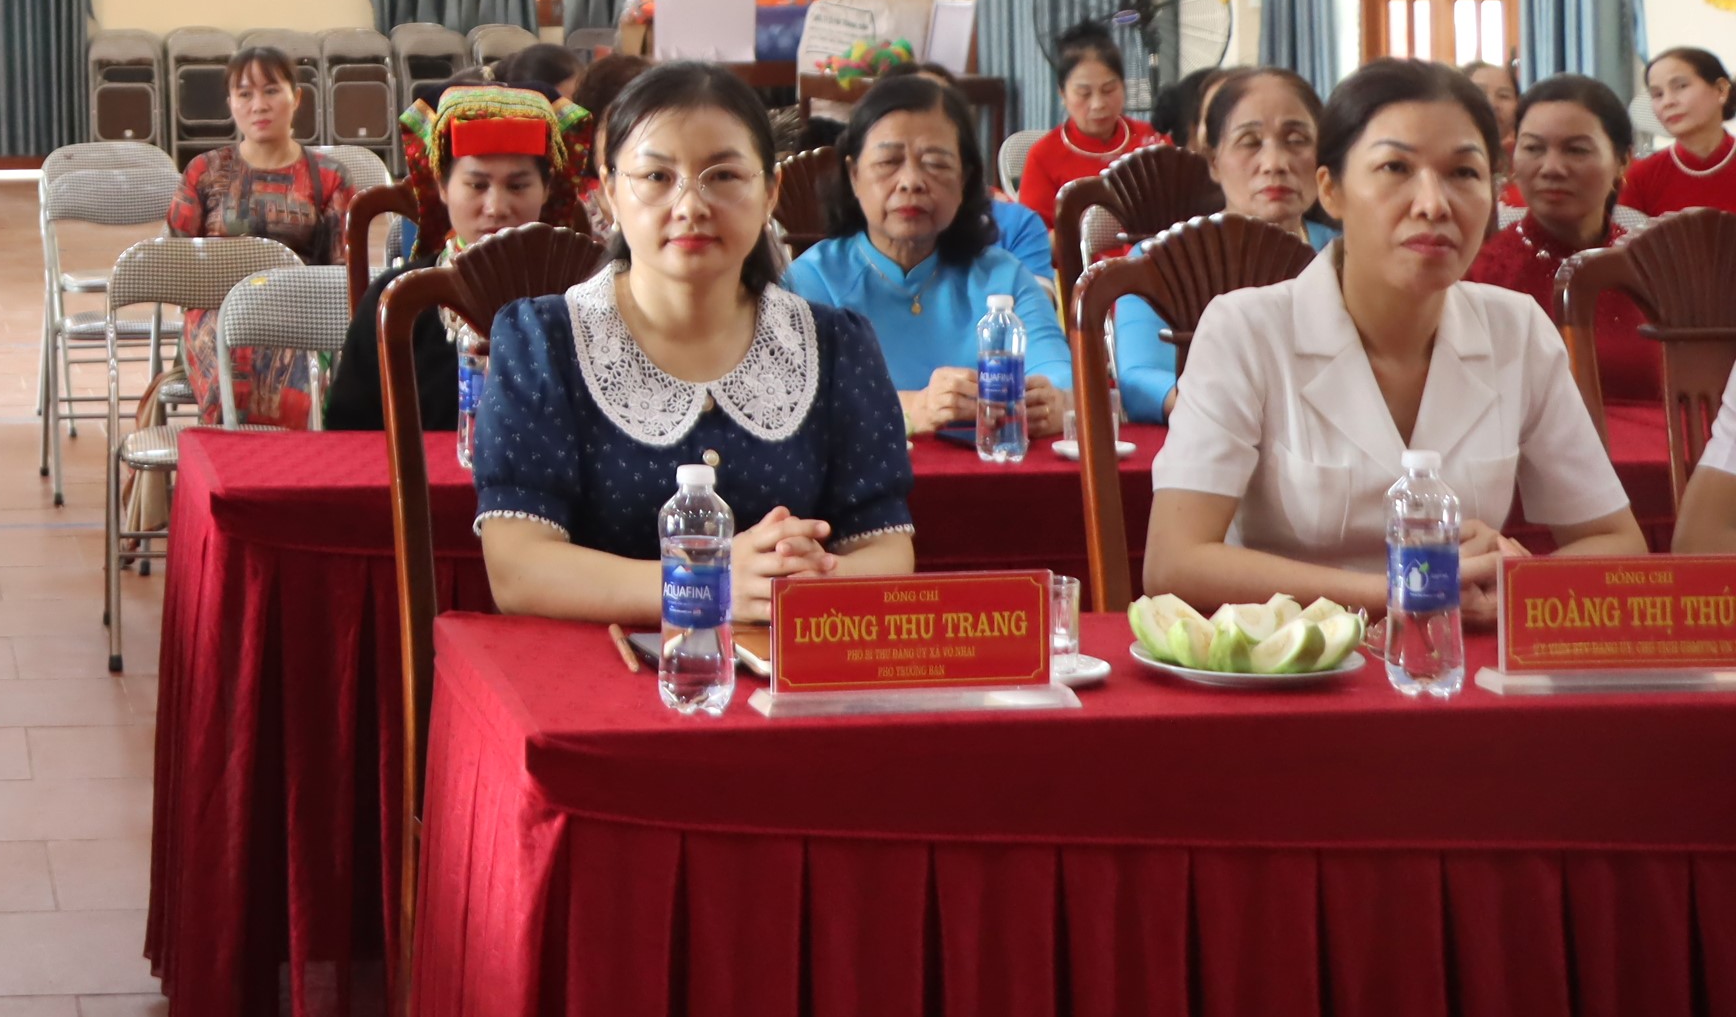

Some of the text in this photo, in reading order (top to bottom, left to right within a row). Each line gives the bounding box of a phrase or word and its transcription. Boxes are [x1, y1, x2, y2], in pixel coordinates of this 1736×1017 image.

[1605, 566, 1675, 585] ĐỒNG CHÍ
[663, 581, 712, 601] AQUAFINA
[884, 586, 939, 603] ĐỒNG CHÍ
[1525, 588, 1621, 628] HOÀNG
[1627, 596, 1674, 636] THỊ
[794, 608, 1028, 643] LƯỜNG THU TRANG
